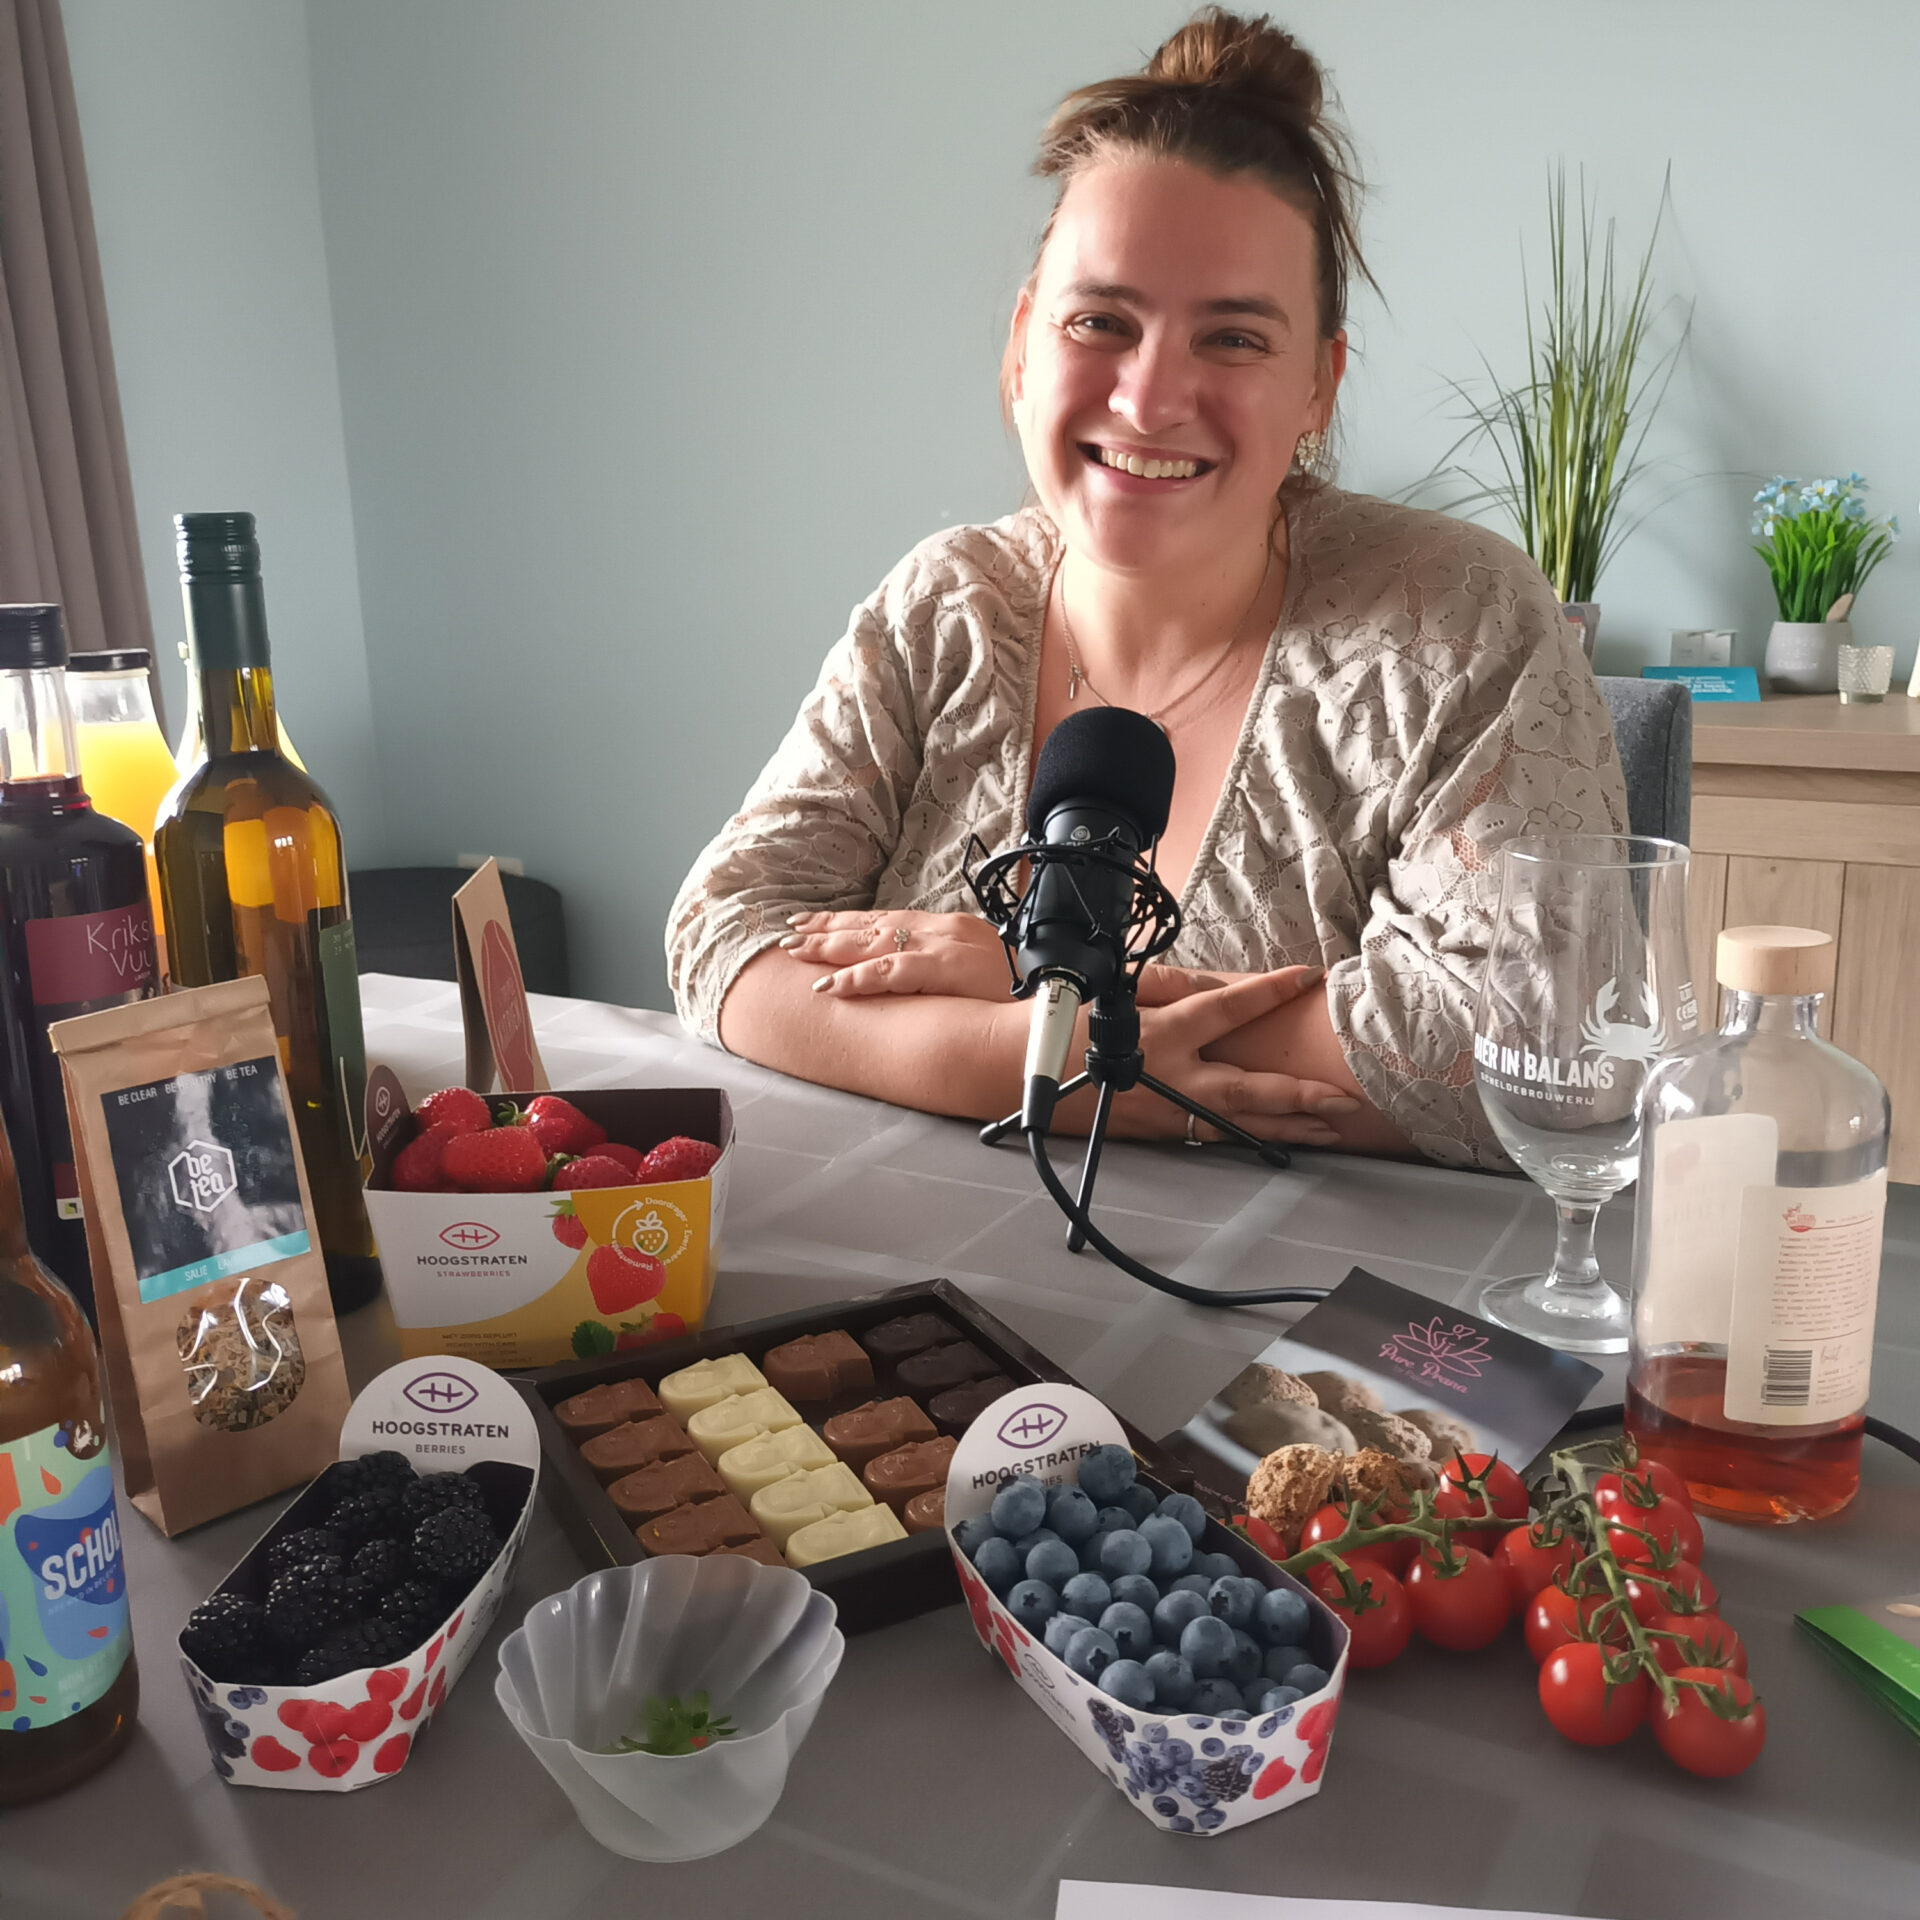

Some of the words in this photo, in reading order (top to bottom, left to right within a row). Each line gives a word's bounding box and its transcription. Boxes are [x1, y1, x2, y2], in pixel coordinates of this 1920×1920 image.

[1501, 1046, 1520, 1078] IN
[1524, 1051, 1615, 1089] BALANS
[118, 1093, 130, 1106] BE
[130, 1087, 158, 1103] CLEAR
[164, 1082, 177, 1094] BE
[225, 1069, 239, 1081] BE
[239, 1064, 259, 1078] TEA
[1480, 1072, 1595, 1106] SCHELDEBROUWERIJ
[416, 1255, 528, 1266] HOOGSTRATEN
[436, 1270, 511, 1278] STRAWBERRIES
[372, 1421, 509, 1438] HOOGSTRATEN
[415, 1444, 466, 1455] BERRIES
